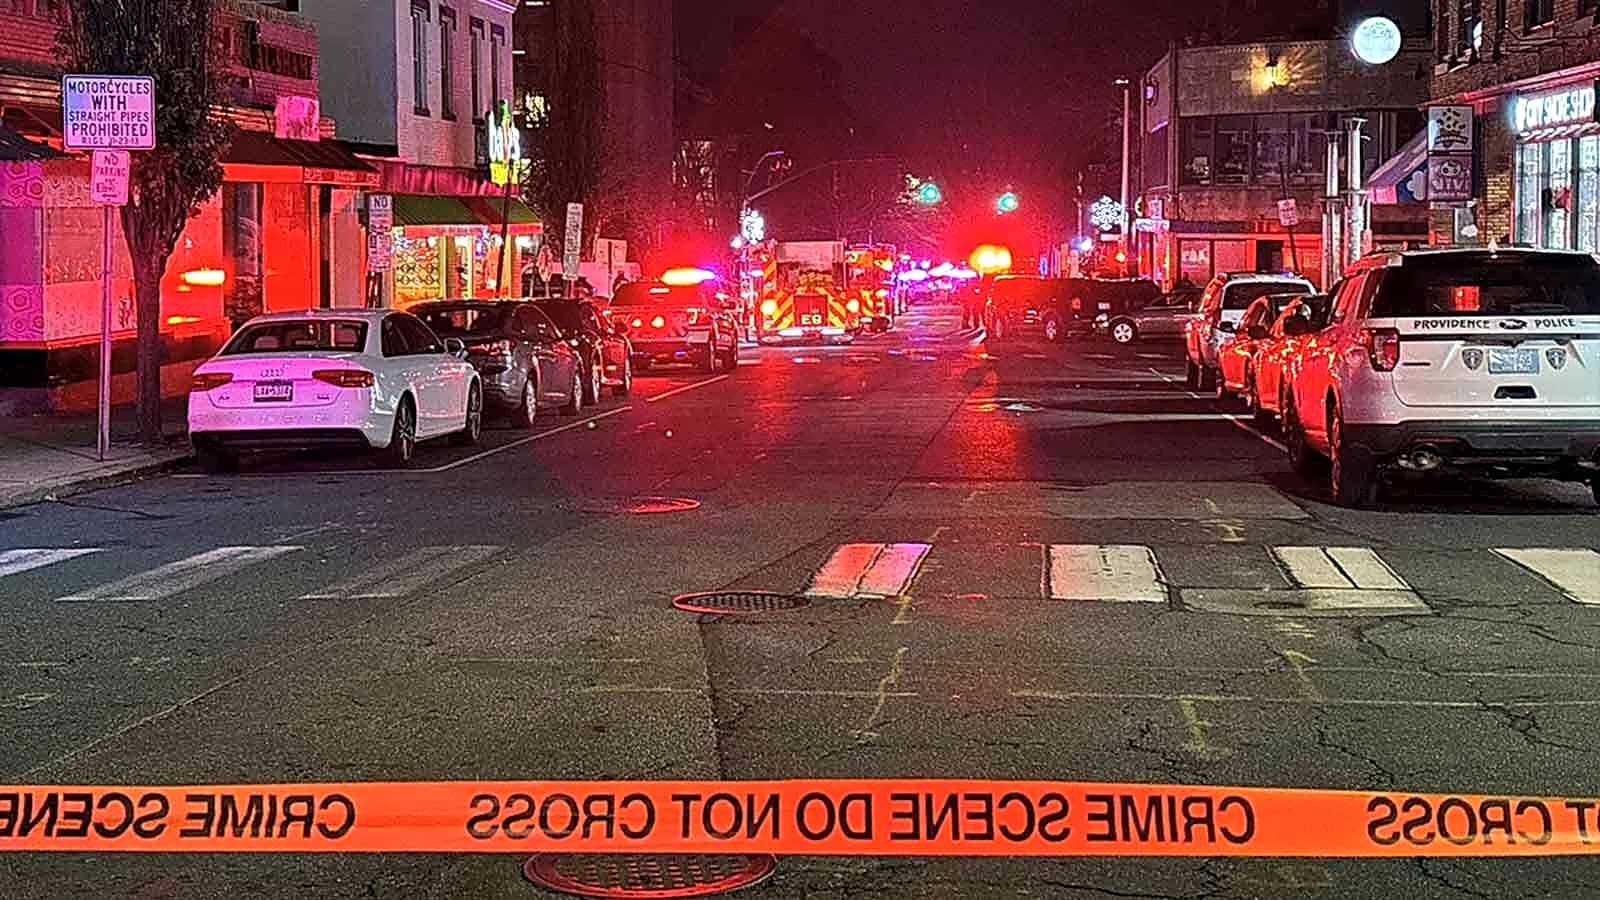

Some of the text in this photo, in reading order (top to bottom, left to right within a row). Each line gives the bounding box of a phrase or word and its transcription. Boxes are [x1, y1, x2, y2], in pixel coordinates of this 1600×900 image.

[68, 81, 150, 95] MOTORCYCLES
[91, 95, 127, 110] WITH
[69, 111, 150, 122] STRAIGHT PIPES
[72, 123, 148, 136] PROHIBITED
[103, 154, 119, 166] NO
[95, 166, 126, 177] PARKING
[373, 196, 388, 209] NO
[1414, 318, 1577, 329] PROVIDENCE POLICE
